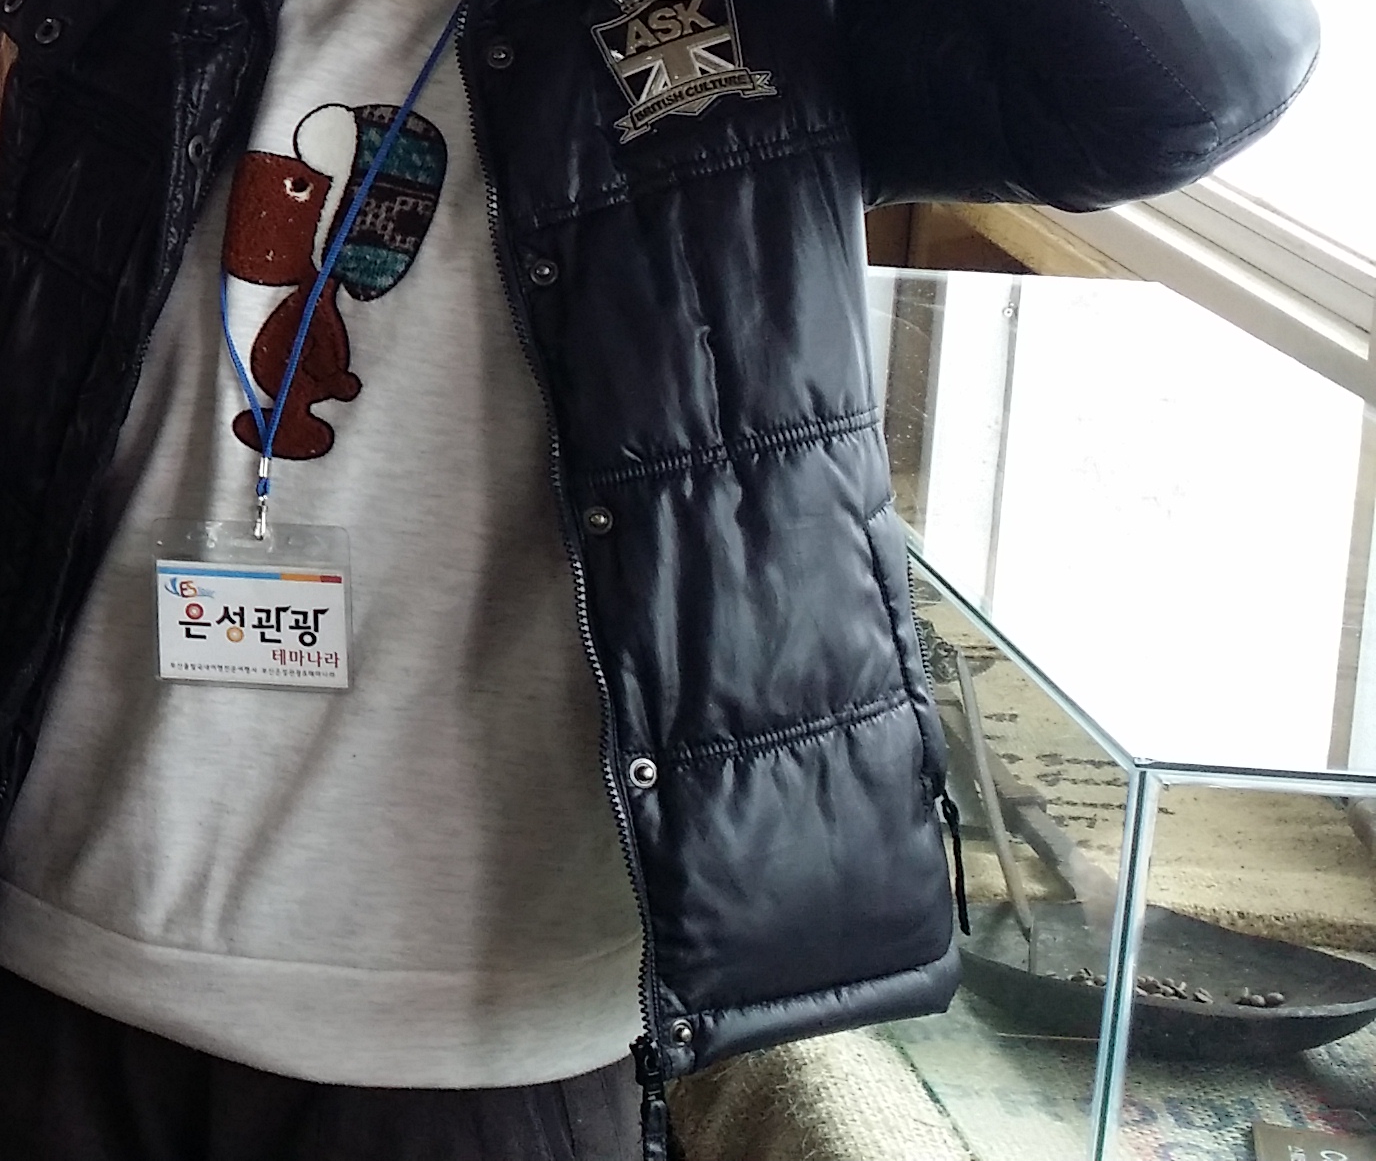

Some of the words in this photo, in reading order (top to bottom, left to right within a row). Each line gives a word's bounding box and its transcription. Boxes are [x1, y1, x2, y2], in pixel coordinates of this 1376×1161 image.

[633, 90, 685, 123] BRITISH
[685, 73, 750, 99] CULTURE
[178, 602, 330, 648] 은성관광
[271, 648, 341, 669] 테마나라
